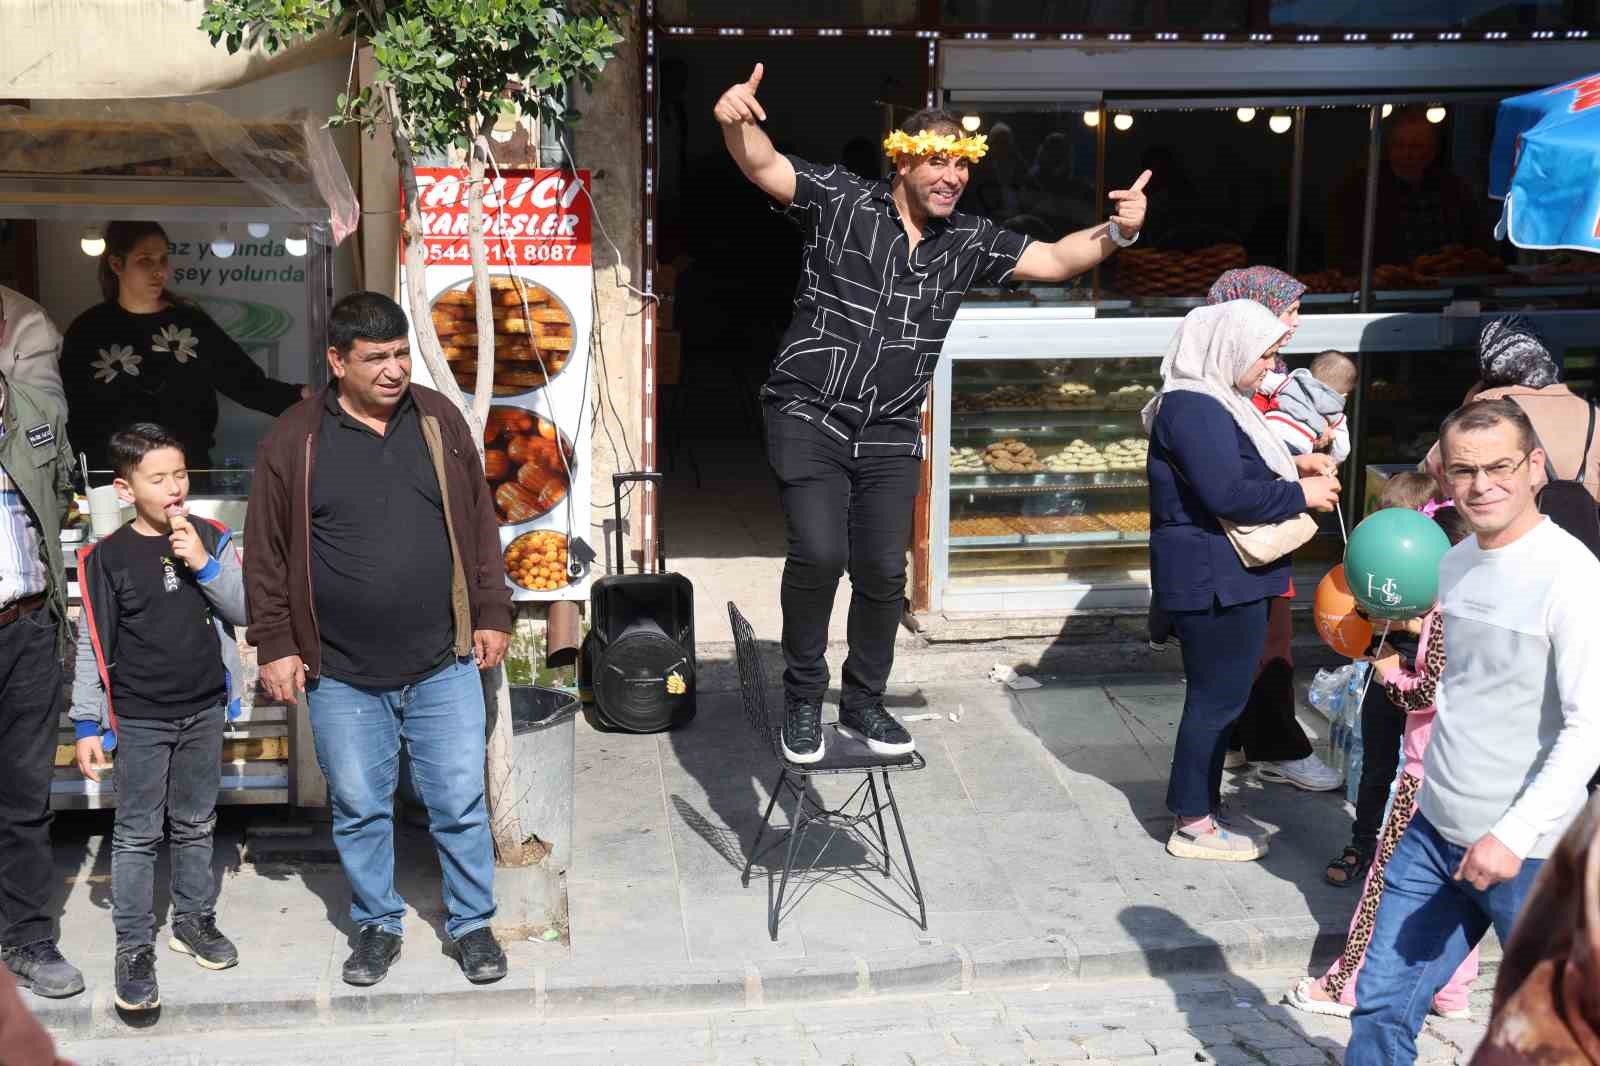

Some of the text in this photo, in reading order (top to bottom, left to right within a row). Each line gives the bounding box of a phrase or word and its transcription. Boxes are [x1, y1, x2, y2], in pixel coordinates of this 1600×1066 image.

[199, 238, 285, 260] yunda
[523, 243, 577, 262] 8087
[174, 264, 304, 286] şey yolunda
